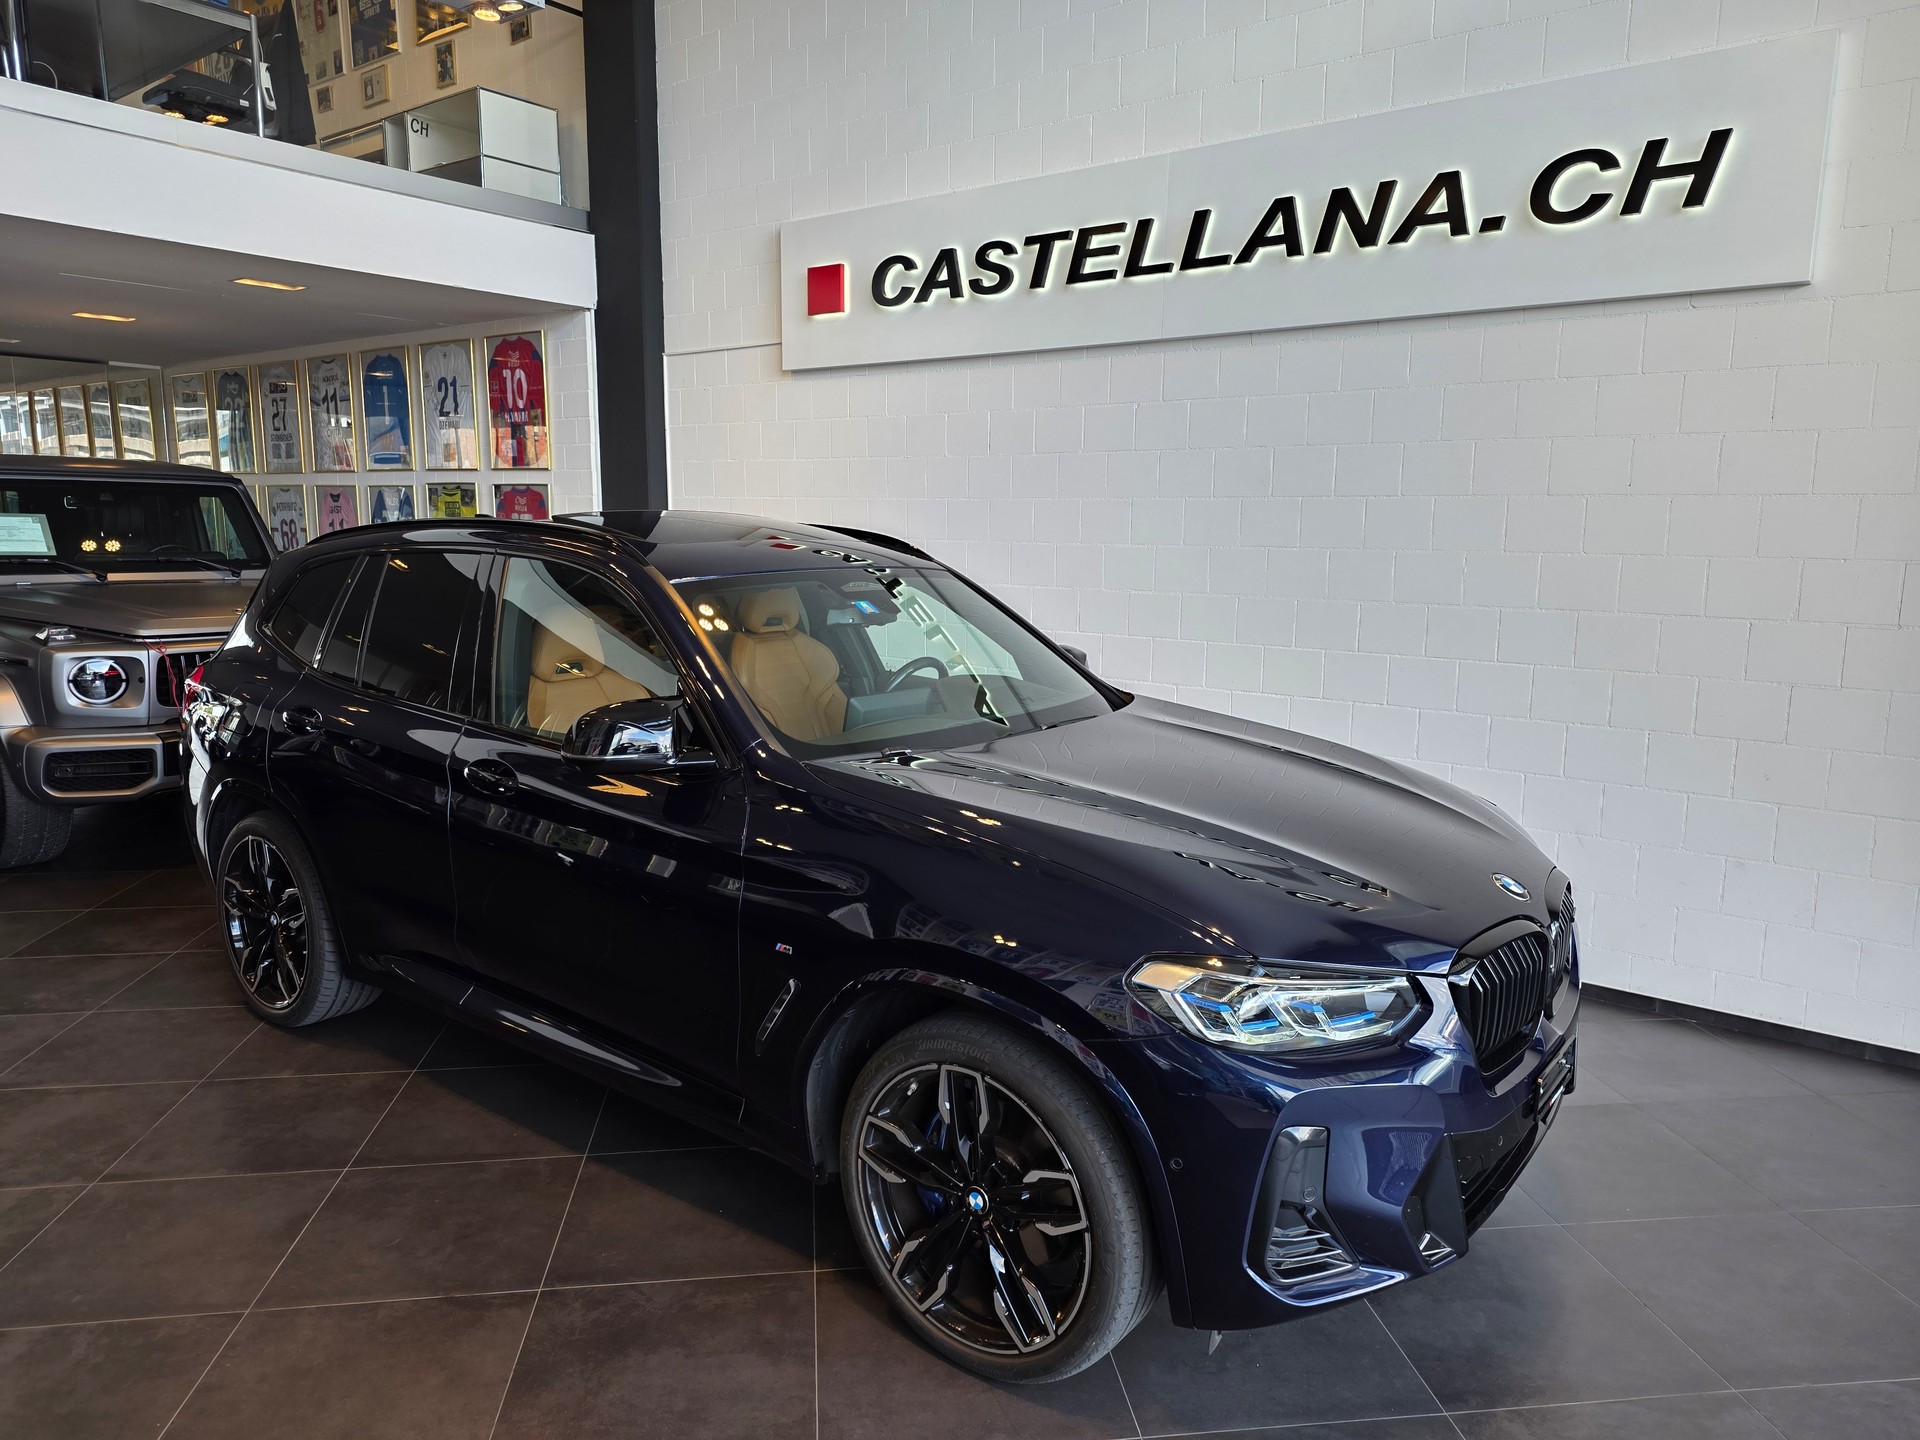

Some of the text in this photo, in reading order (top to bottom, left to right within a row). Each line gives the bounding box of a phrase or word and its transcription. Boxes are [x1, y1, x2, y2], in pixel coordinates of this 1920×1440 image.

[411, 118, 429, 137] CH
[871, 128, 1734, 308] CASTELLANA.CH
[322, 388, 339, 425] 11
[438, 376, 459, 417] 21
[503, 369, 528, 409] 10
[271, 397, 287, 431] 27
[281, 519, 299, 550] 68
[918, 1039, 993, 1064] BRIDGESTONE
